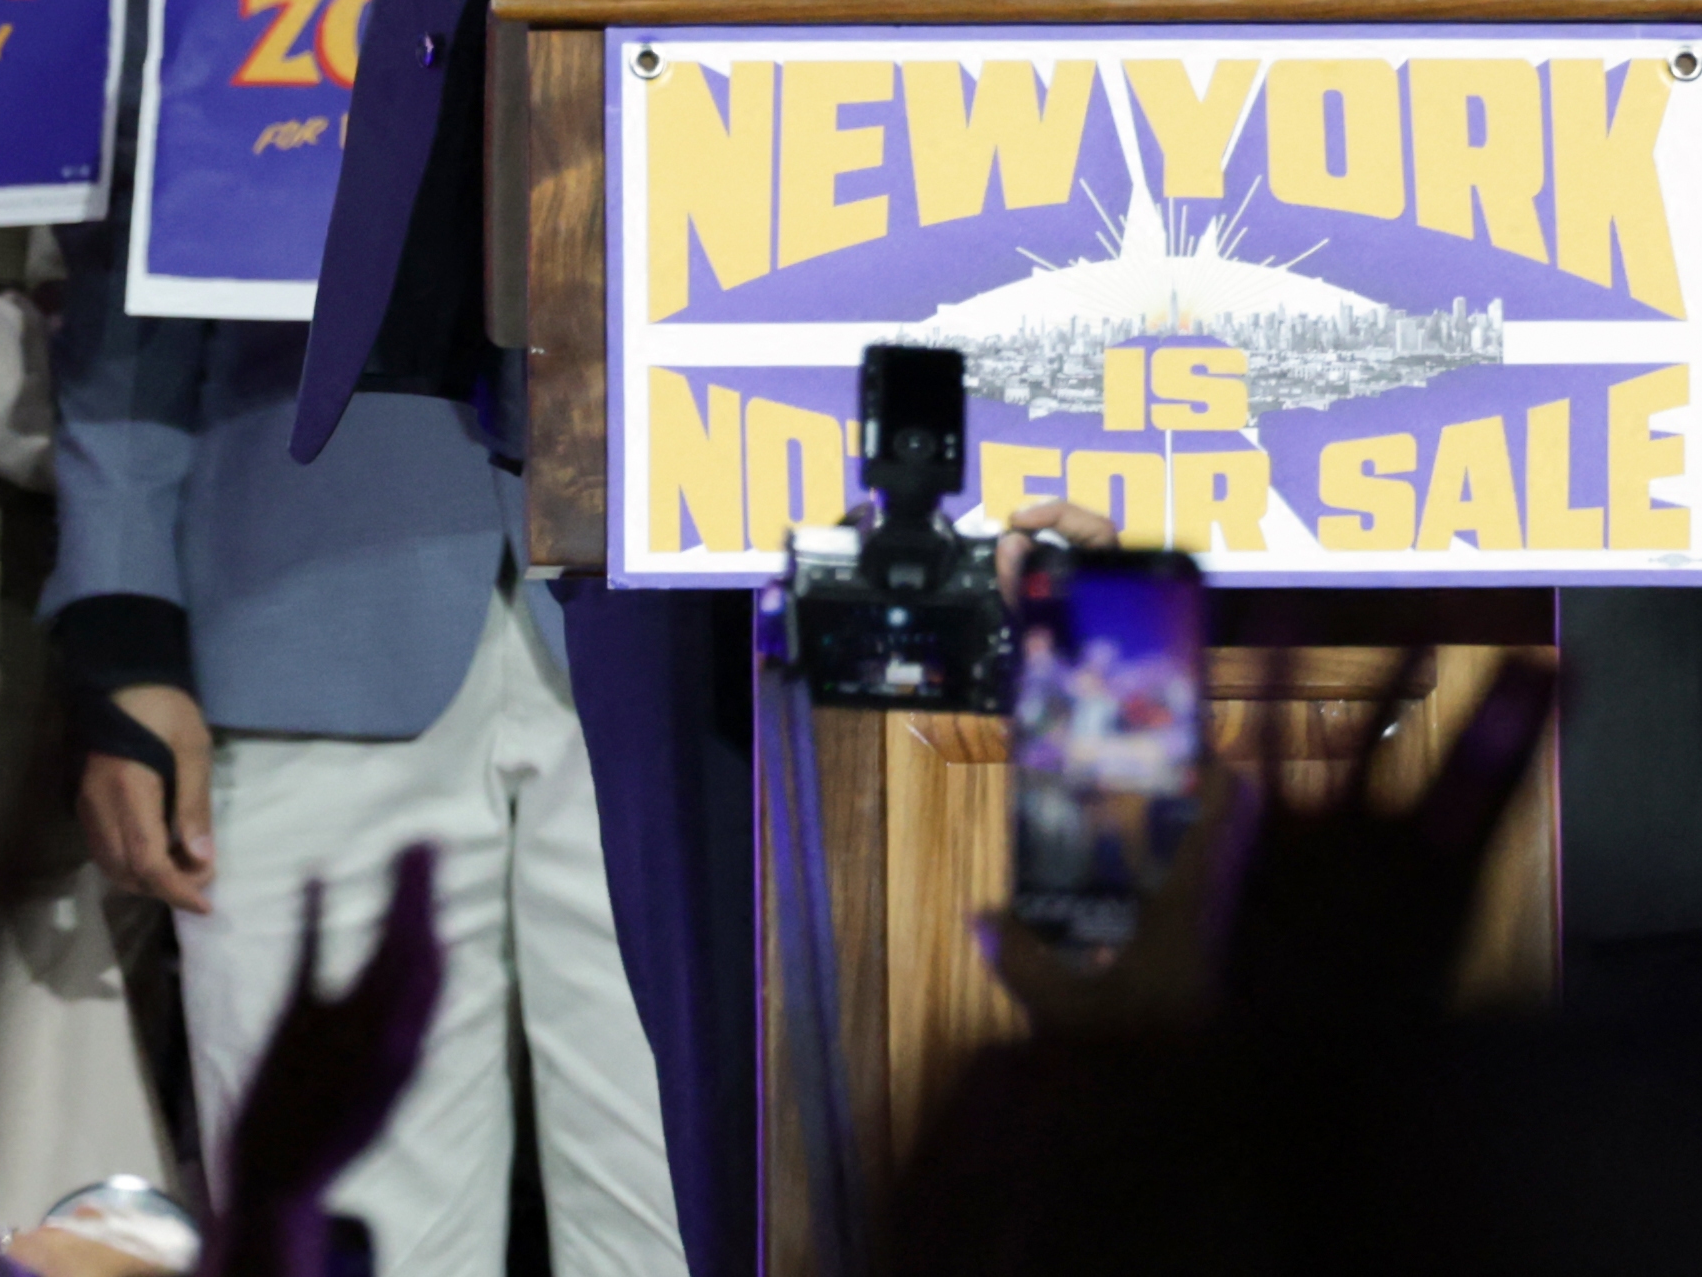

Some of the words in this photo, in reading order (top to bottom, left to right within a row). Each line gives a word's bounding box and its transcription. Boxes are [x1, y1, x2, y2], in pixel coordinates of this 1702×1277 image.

[646, 58, 1098, 325] NEW
[1121, 58, 1688, 322] YORK
[647, 364, 862, 554] NO
[979, 440, 1272, 553] FOR
[1317, 361, 1691, 552] SALE
[1102, 346, 1249, 432] IS
